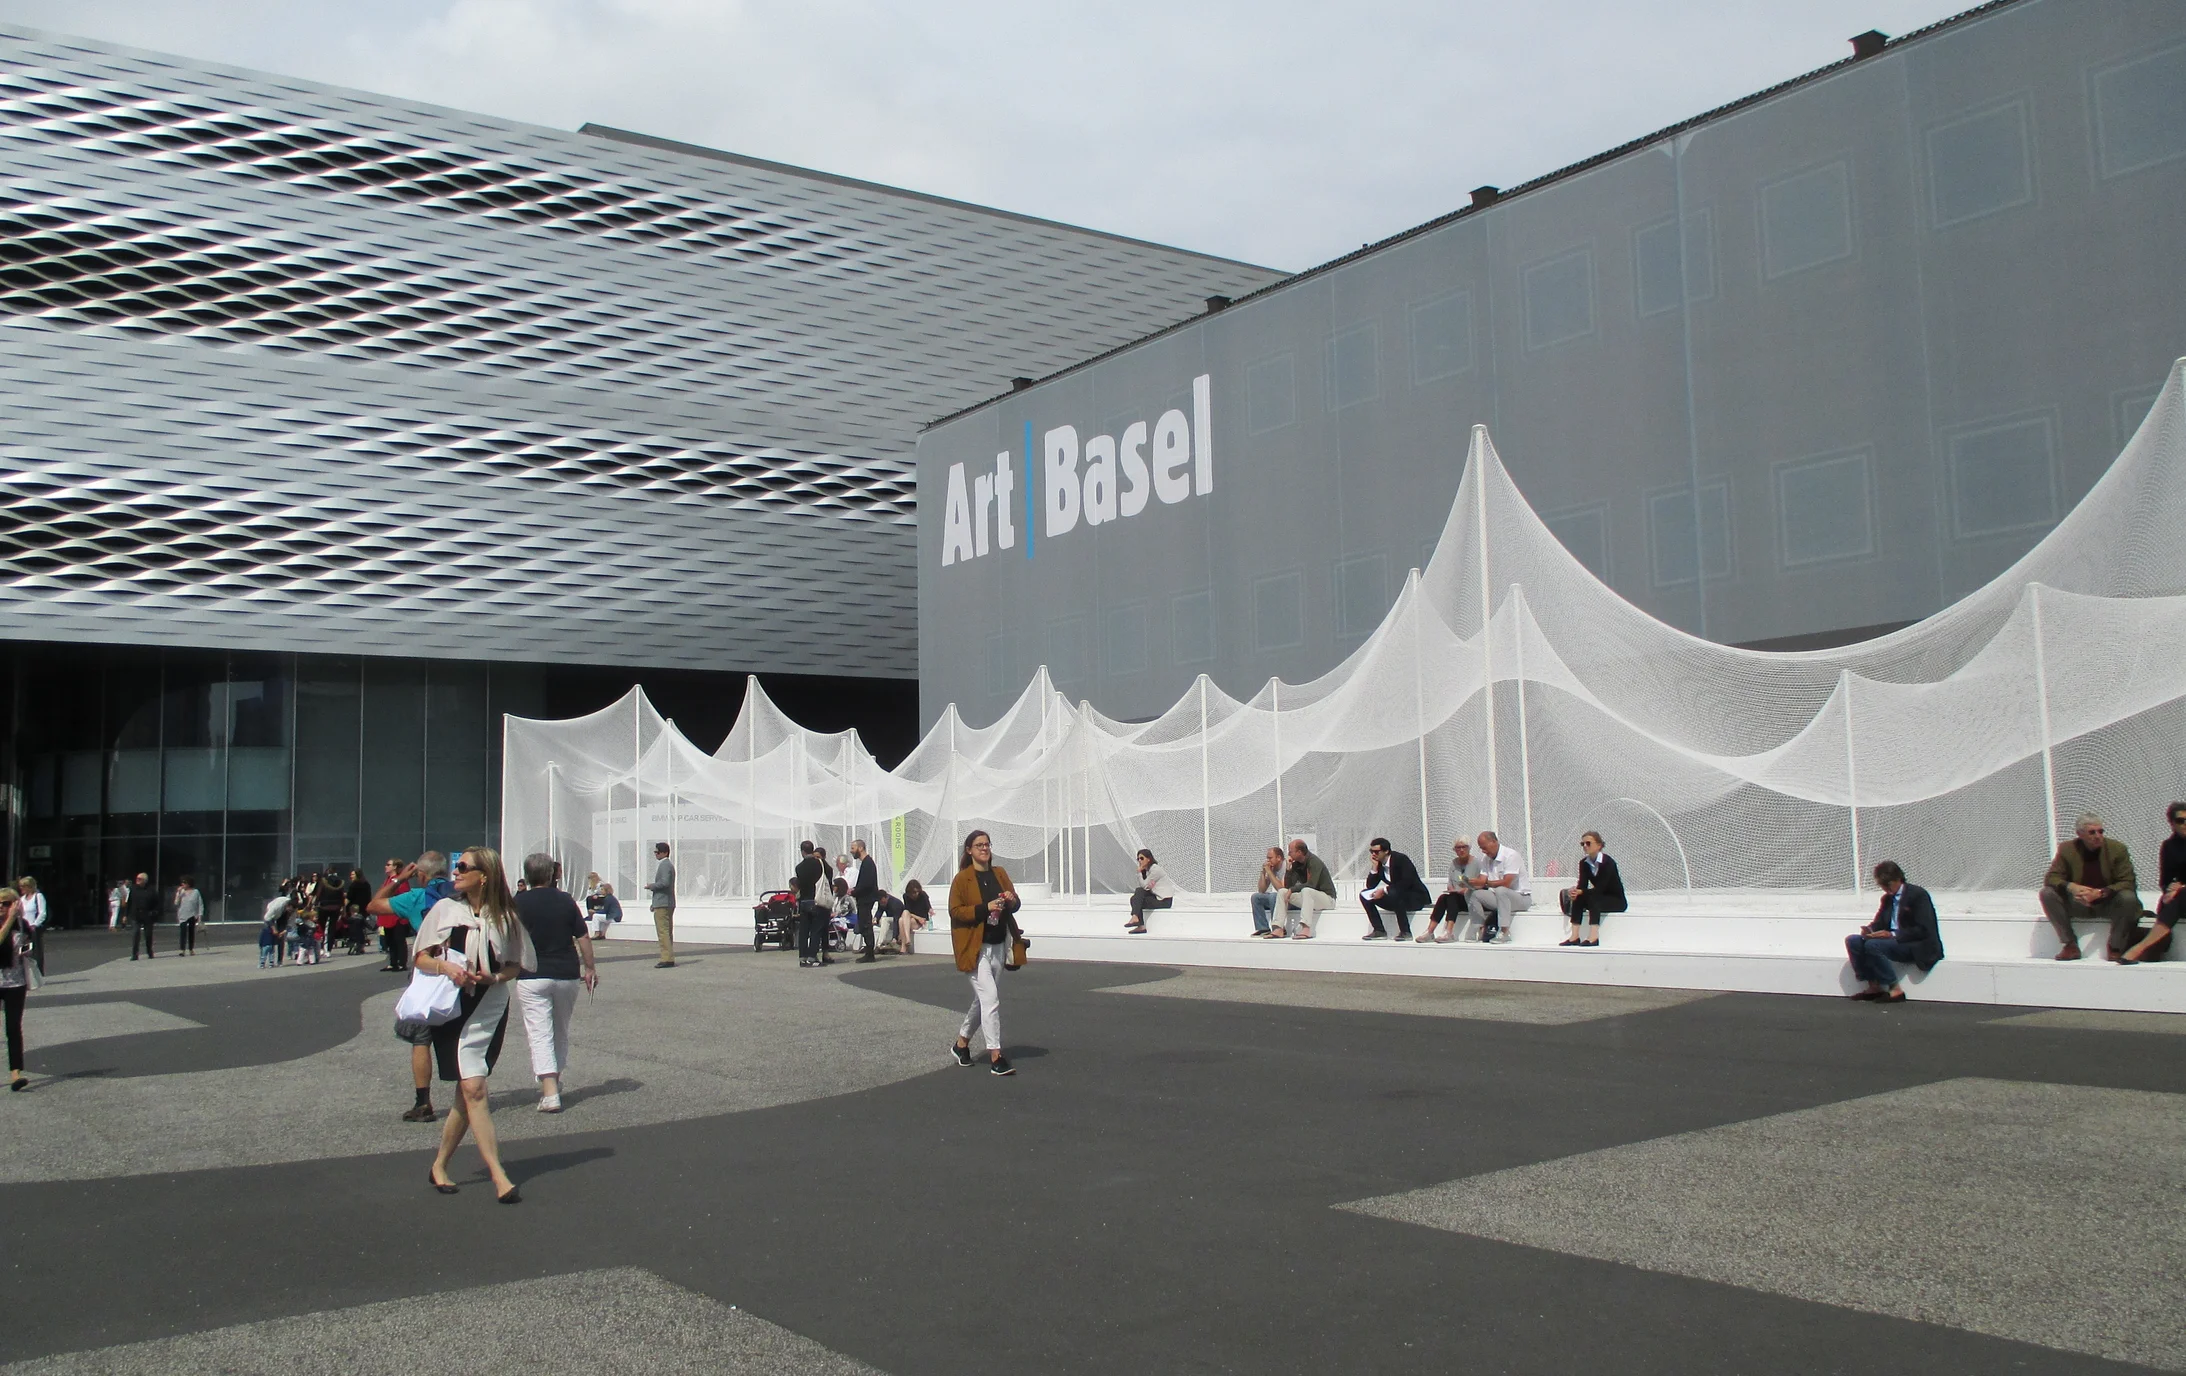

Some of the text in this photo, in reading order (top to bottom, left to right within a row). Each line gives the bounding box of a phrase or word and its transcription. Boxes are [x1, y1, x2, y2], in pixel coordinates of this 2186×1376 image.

[942, 374, 1213, 567] Art Basel
[670, 814, 683, 822] VP
[684, 814, 699, 822] CAR
